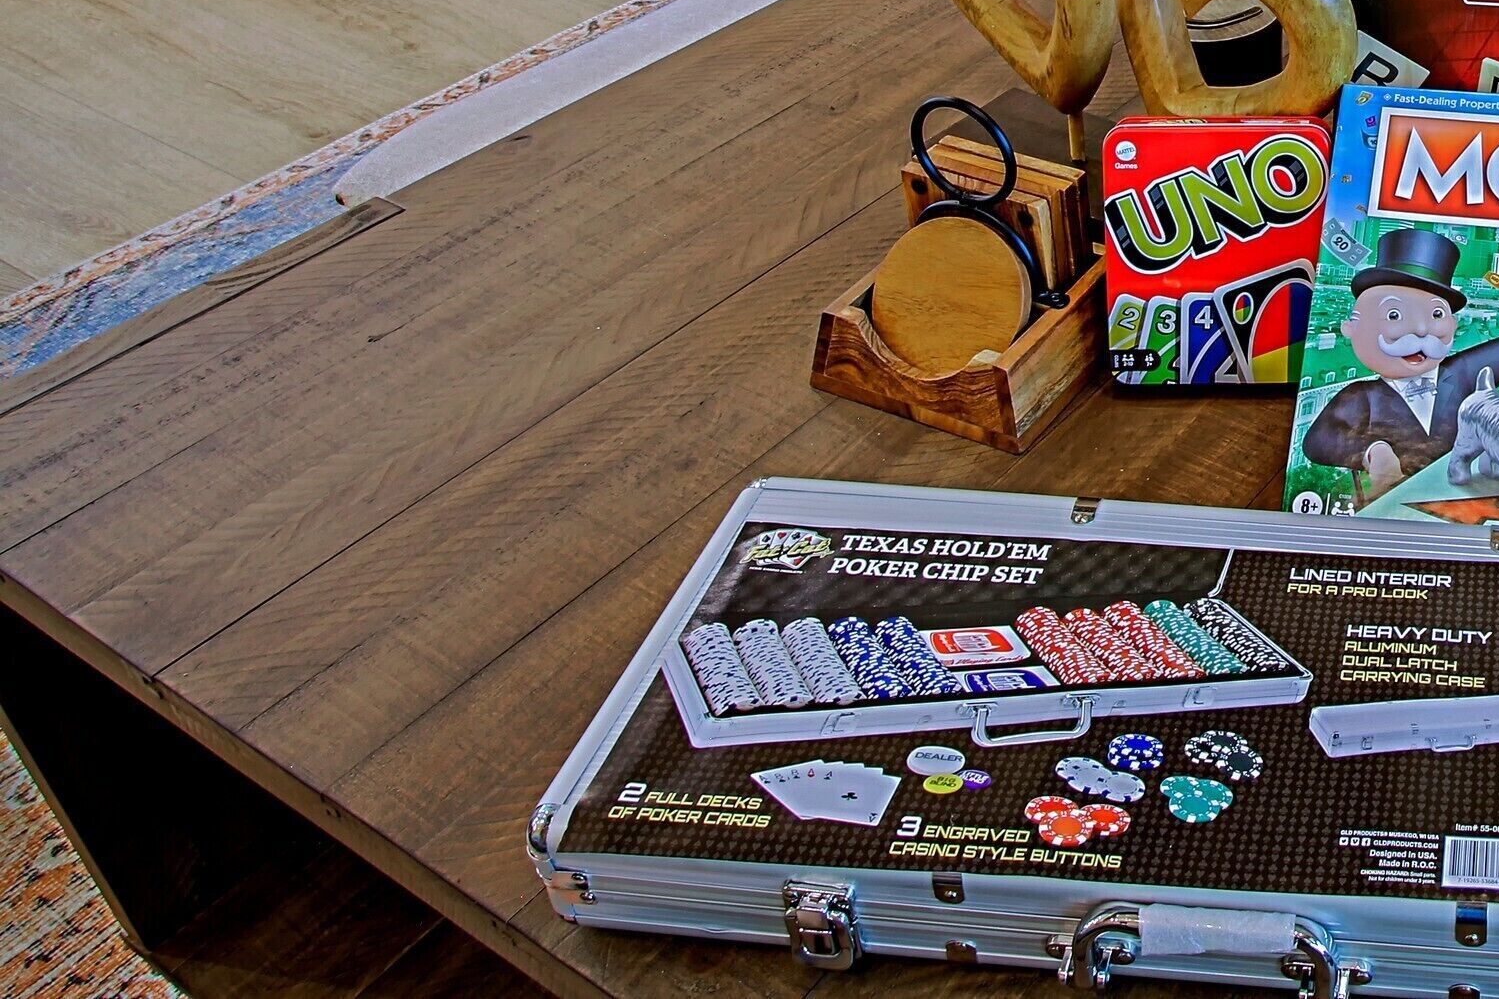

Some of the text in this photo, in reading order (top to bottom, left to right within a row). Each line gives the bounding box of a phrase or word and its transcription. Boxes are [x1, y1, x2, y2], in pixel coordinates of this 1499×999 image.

[1394, 93, 1458, 110] Fast-Dealing
[1112, 137, 1326, 265] UNO
[1333, 237, 1350, 251] 20
[1119, 307, 1141, 330] 2
[1157, 309, 1177, 334] 3
[1194, 305, 1214, 330] 4
[1300, 499, 1319, 514] 8+
[840, 535, 1052, 561] TEXAS HOLD'EM
[827, 557, 920, 579] POKER
[922, 563, 989, 582] CHIP
[991, 566, 1044, 585] SET
[1289, 567, 1453, 588] LINED INTERIOR
[1287, 583, 1429, 600] FOR A PRO LOOK
[1346, 624, 1493, 645] HEAVY DUTY
[1344, 641, 1437, 656] ALUMINUM
[1342, 655, 1458, 672] DUAL LATCH
[1340, 670, 1486, 689] CARRYING CASE
[914, 751, 964, 762] DEALER
[618, 782, 763, 810] 2 FULL DECKS
[607, 805, 772, 828] OF POKER CARDS
[896, 815, 1031, 844] 3 ENGRAVED
[888, 841, 1123, 868] CASINO STYLE BUTTONS
[1369, 849, 1407, 859] Designed
[1373, 839, 1439, 849] GLDPRODUCTS.COM
[1378, 859, 1401, 867] Made
